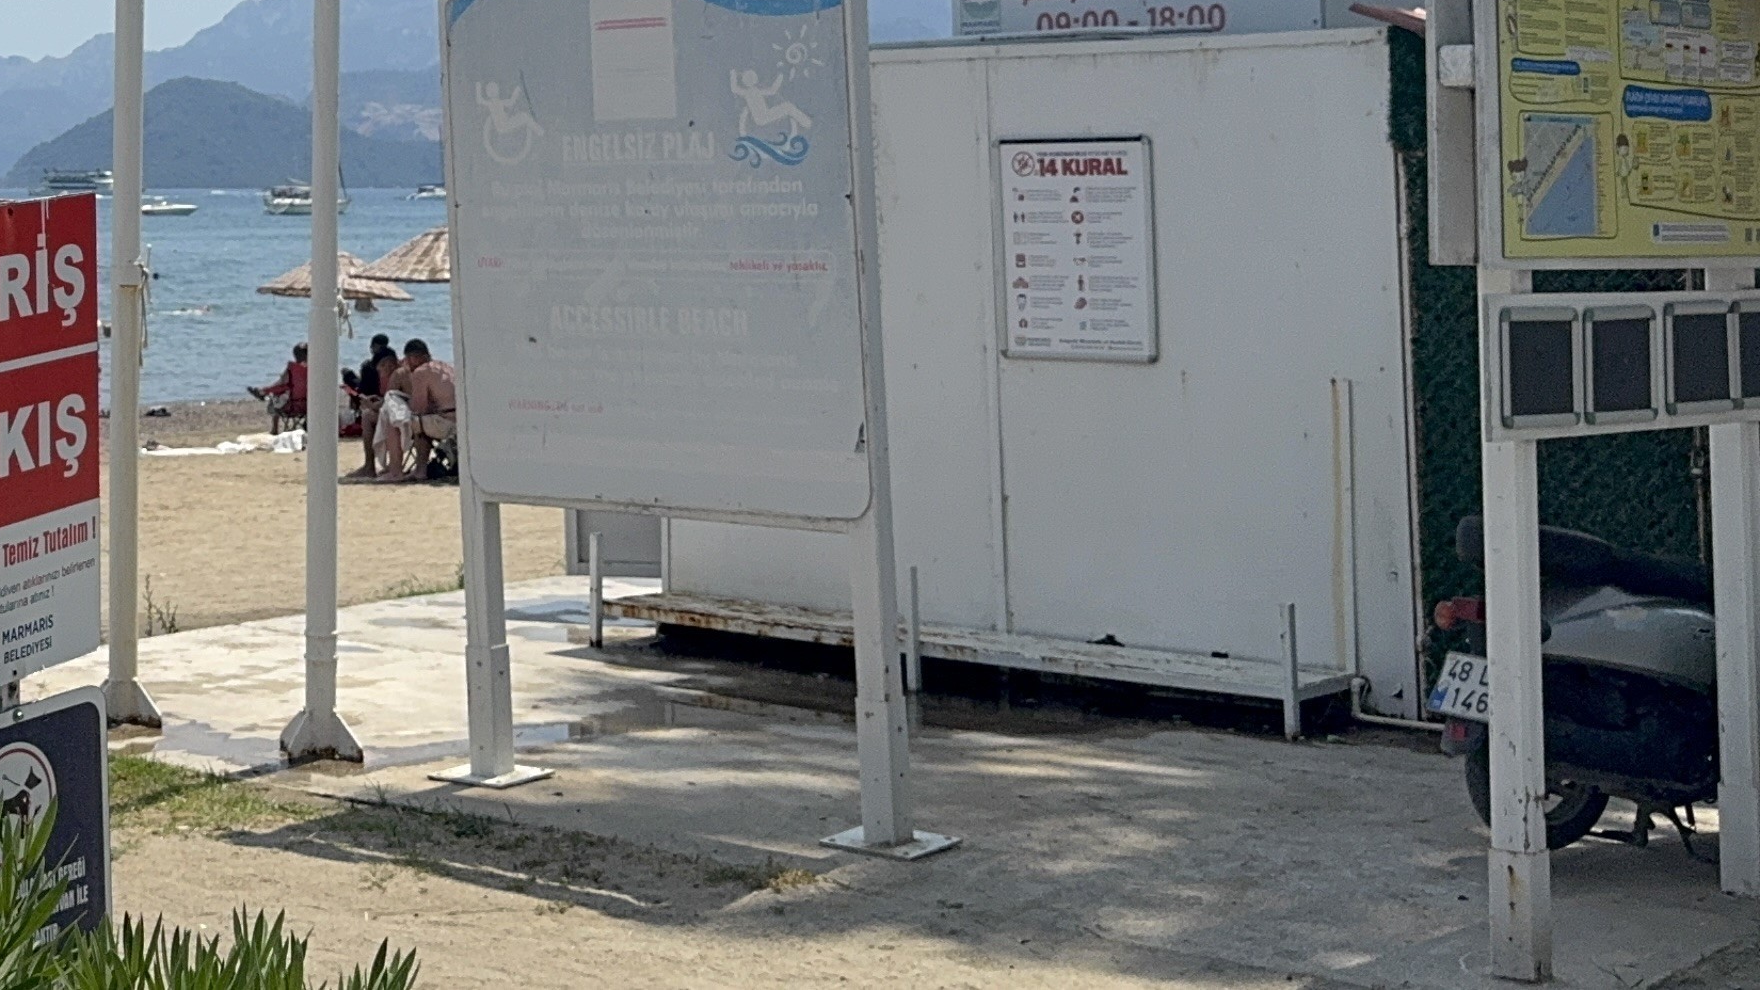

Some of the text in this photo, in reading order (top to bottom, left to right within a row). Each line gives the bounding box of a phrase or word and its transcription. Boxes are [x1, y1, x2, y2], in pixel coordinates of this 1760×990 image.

[1061, 157, 1128, 176] KURAL
[2, 536, 39, 568] Temiz
[43, 521, 88, 556] Tutalım
[1448, 660, 1473, 681] 48
[1451, 688, 1488, 713] 146
